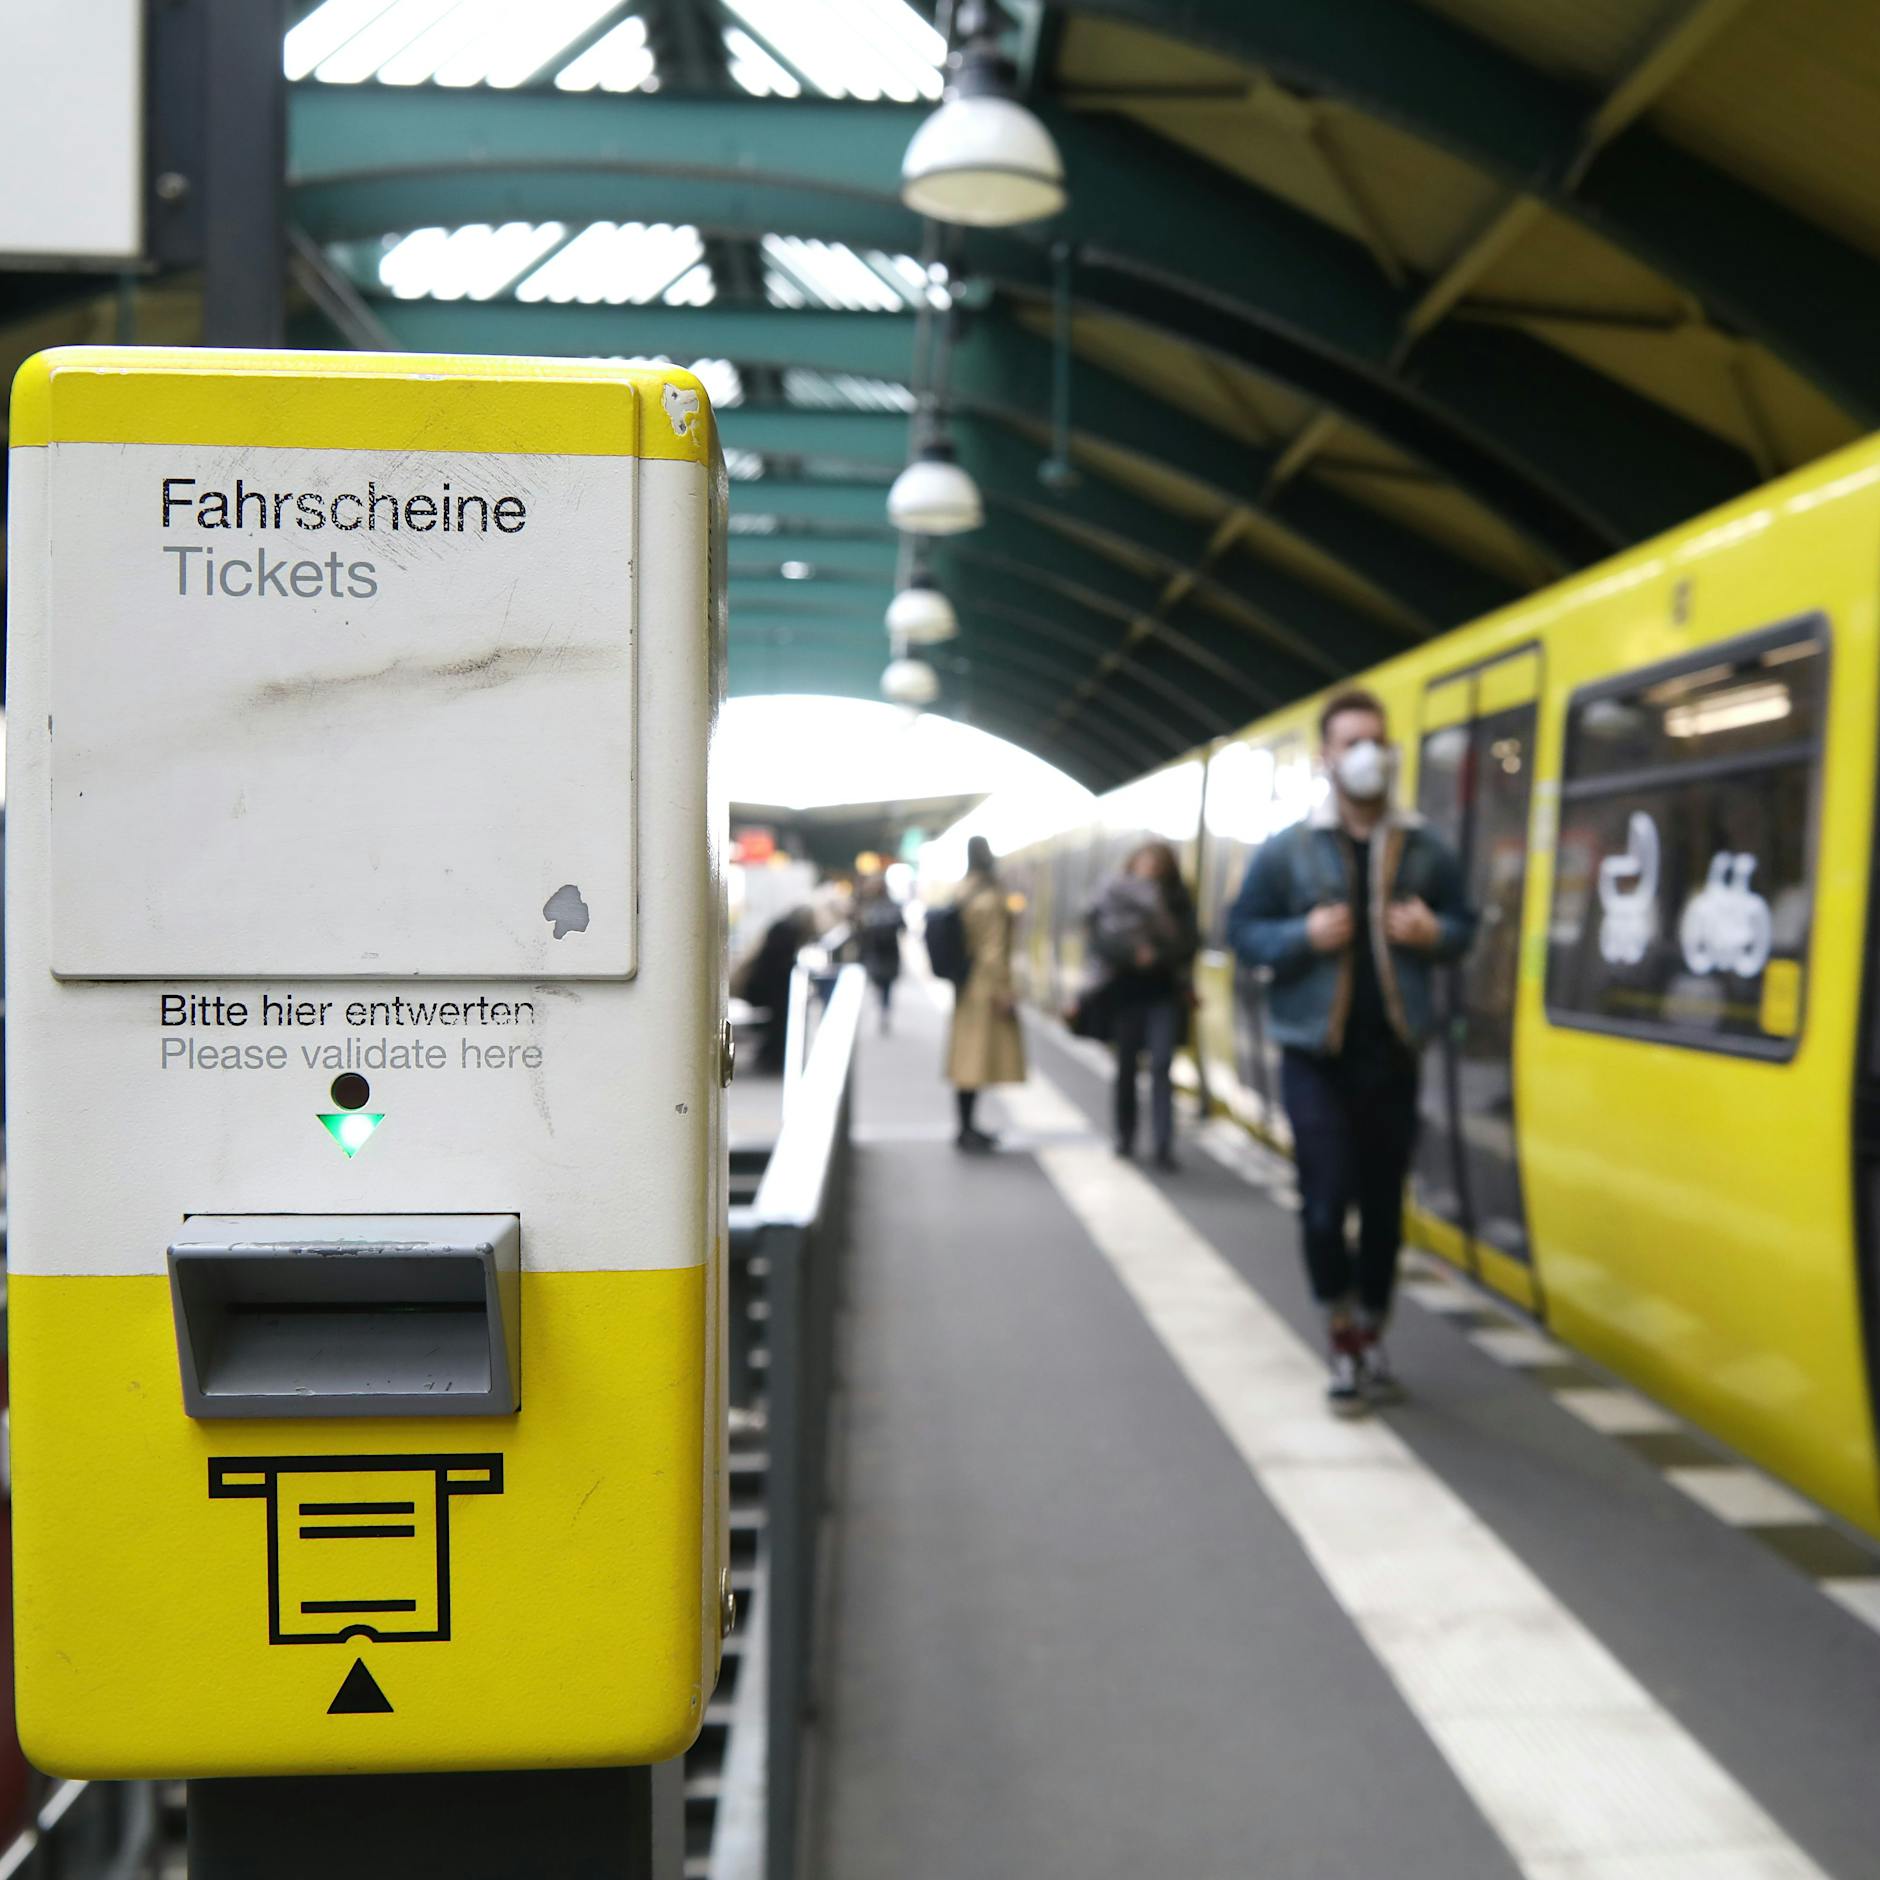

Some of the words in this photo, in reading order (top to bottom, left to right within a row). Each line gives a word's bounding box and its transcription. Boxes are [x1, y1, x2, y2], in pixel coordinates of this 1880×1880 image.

[162, 478, 526, 533] Fahrscheine
[162, 545, 378, 598] Tickets
[160, 994, 249, 1026] Bitte
[262, 994, 333, 1026] hier
[345, 995, 535, 1026] entwerten
[160, 1037, 288, 1069] Please
[300, 1037, 447, 1069] validate
[461, 1037, 543, 1069] here
